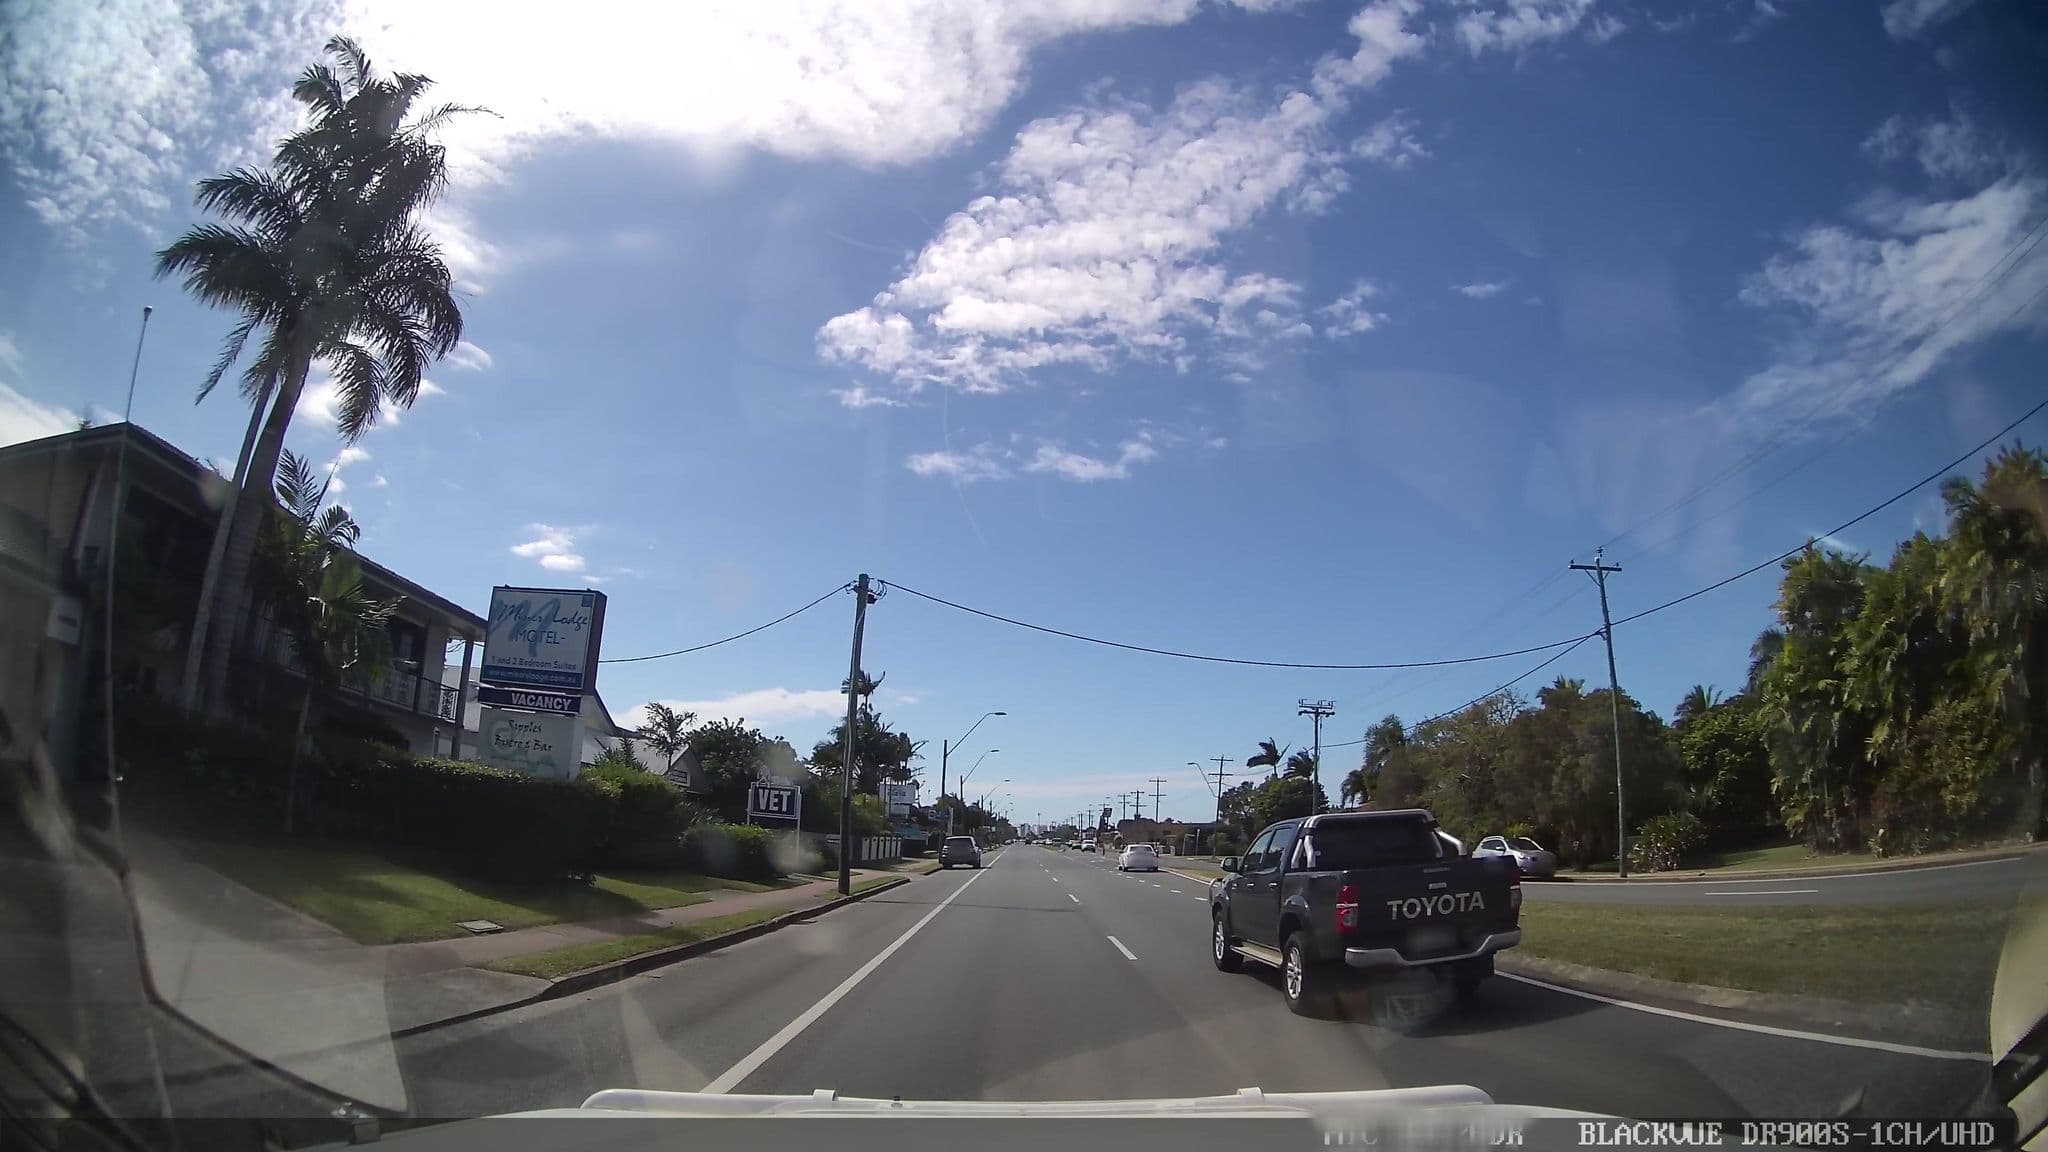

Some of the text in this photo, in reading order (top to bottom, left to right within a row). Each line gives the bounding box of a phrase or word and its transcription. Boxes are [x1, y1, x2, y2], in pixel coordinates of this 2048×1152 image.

[552, 611, 588, 631] Lodge
[497, 657, 510, 665] and
[519, 657, 552, 668] Bedroom
[553, 660, 577, 670] Suites
[511, 692, 573, 710] VACANCY
[532, 739, 553, 752] Bar
[758, 788, 791, 812] VET
[1386, 891, 1486, 920] TOYOTA
